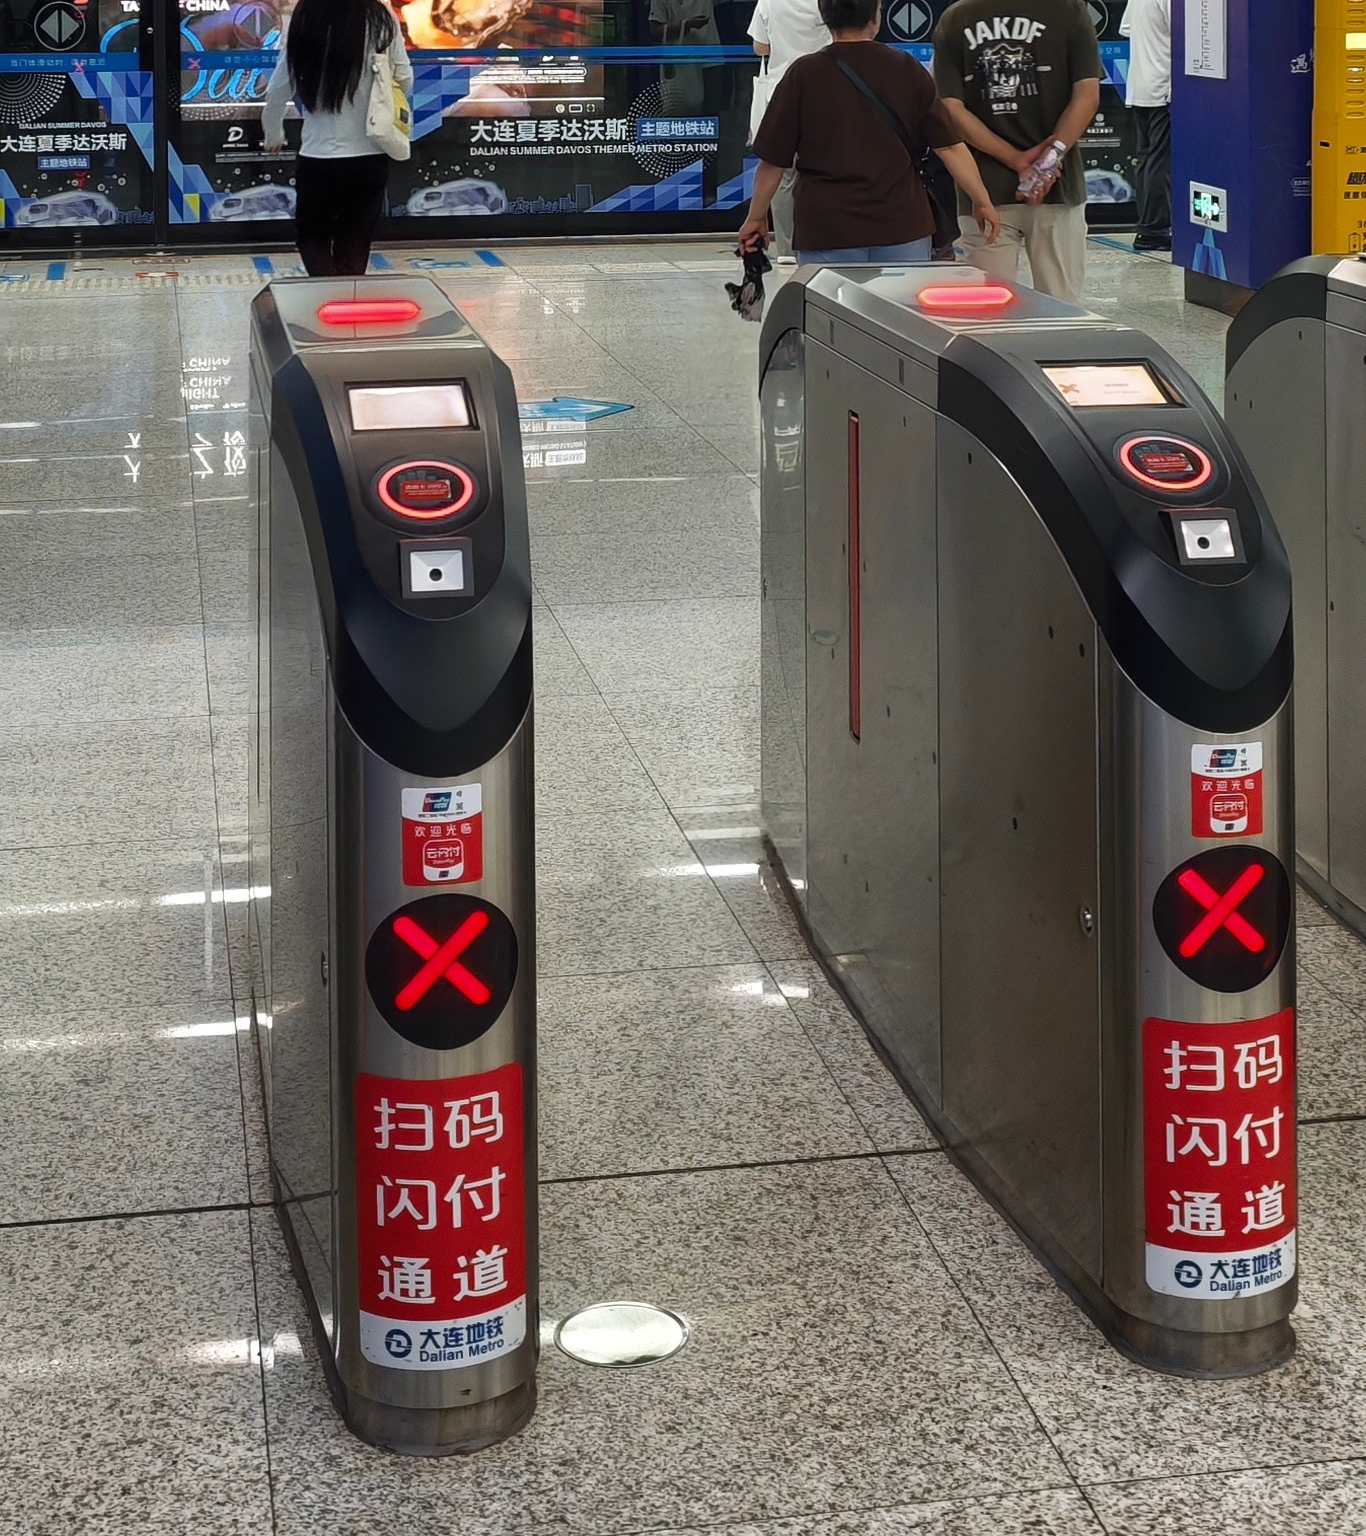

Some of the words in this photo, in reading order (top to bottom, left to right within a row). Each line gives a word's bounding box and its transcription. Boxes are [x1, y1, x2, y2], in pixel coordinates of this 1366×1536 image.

[186, 0, 230, 12] CHINA
[0, 133, 127, 152] 大连夏季达沃斯
[470, 118, 628, 143] 大连夏季达沃斯
[641, 120, 715, 137] 主题地铁站
[470, 147, 508, 156] DALIAN
[510, 146, 554, 156] SUMMER
[556, 145, 591, 155] DAVOS
[593, 144, 635, 154] THEMED
[637, 144, 672, 153] METRO
[674, 143, 717, 153] STATION
[1163, 1034, 1283, 1092] 扫码
[374, 1090, 503, 1152] 扫码
[1166, 1112, 1284, 1167] 闪付
[376, 1165, 507, 1230] 闪付
[1166, 1181, 1286, 1237] 通道
[377, 1245, 508, 1304] 通道
[1210, 1247, 1283, 1281] 大连地铁
[1210, 1276, 1249, 1293] Dalian
[1253, 1270, 1283, 1290] Metro
[419, 1315, 504, 1350] 大连地铁
[419, 1345, 464, 1363] Dalian
[467, 1337, 505, 1359] Metro
